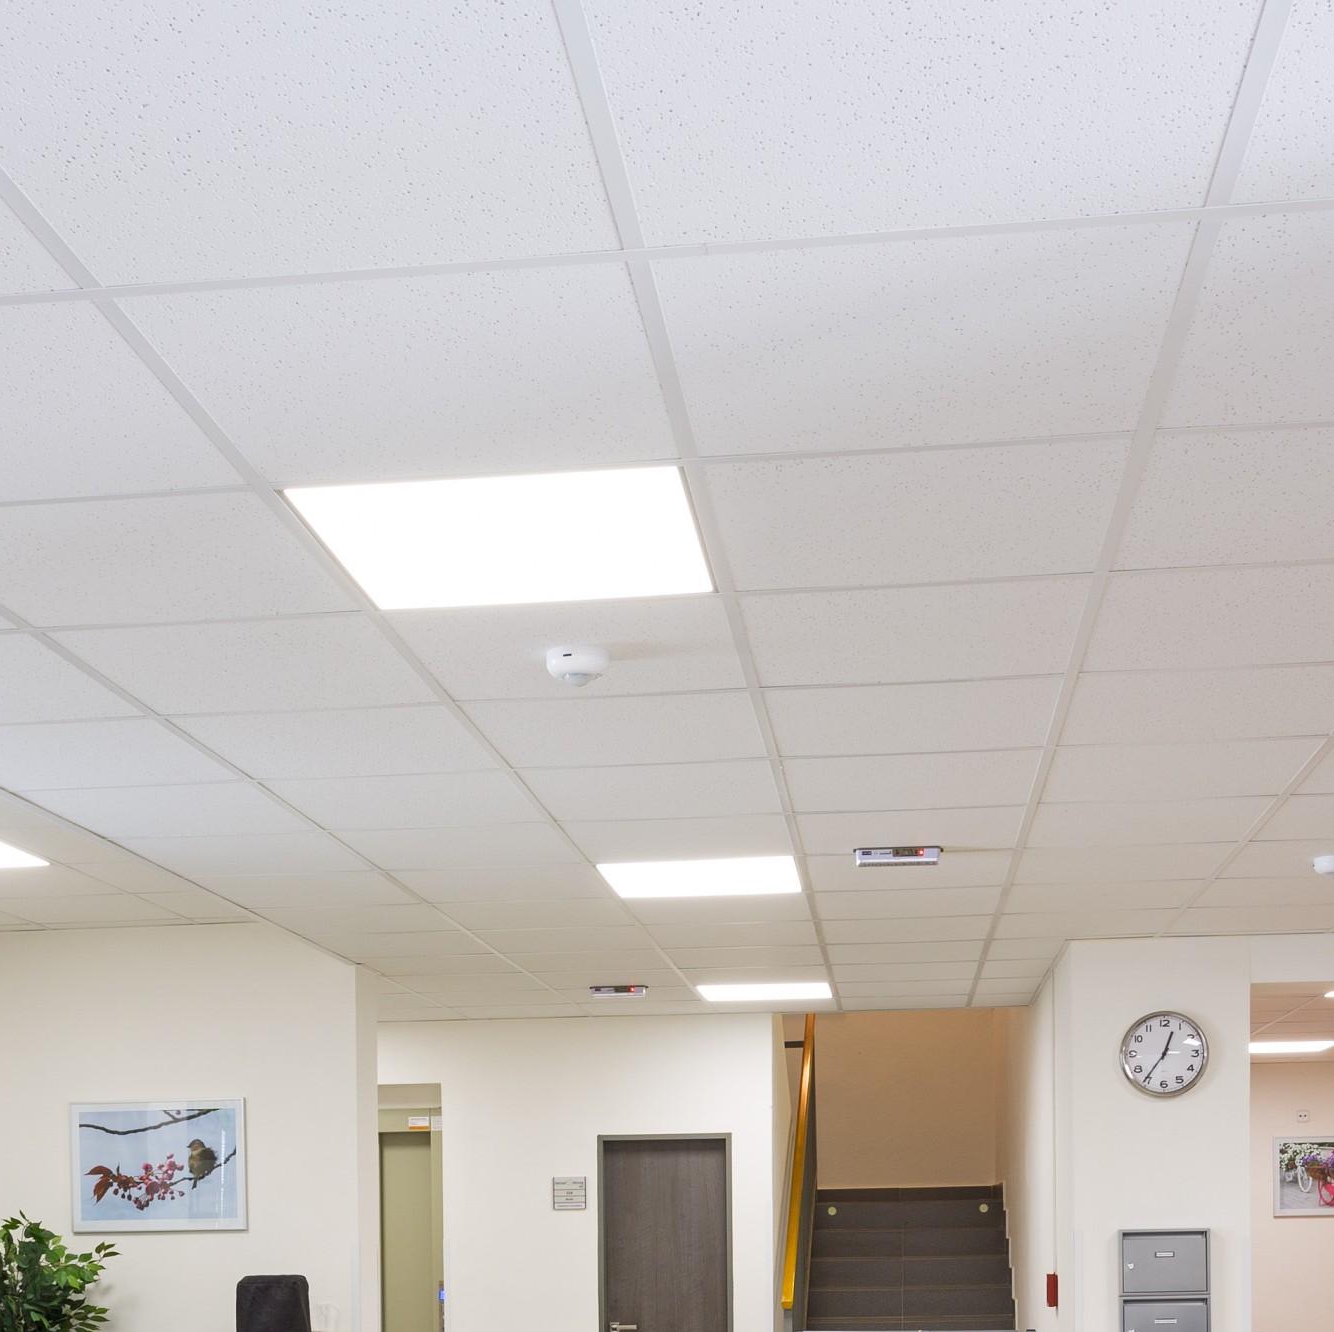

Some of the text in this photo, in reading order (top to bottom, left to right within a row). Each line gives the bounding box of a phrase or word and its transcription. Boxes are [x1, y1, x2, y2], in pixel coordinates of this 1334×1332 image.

[1159, 1019, 1170, 1027] 12
[1145, 1024, 1152, 1032] 11
[1134, 1035, 1143, 1043] 10
